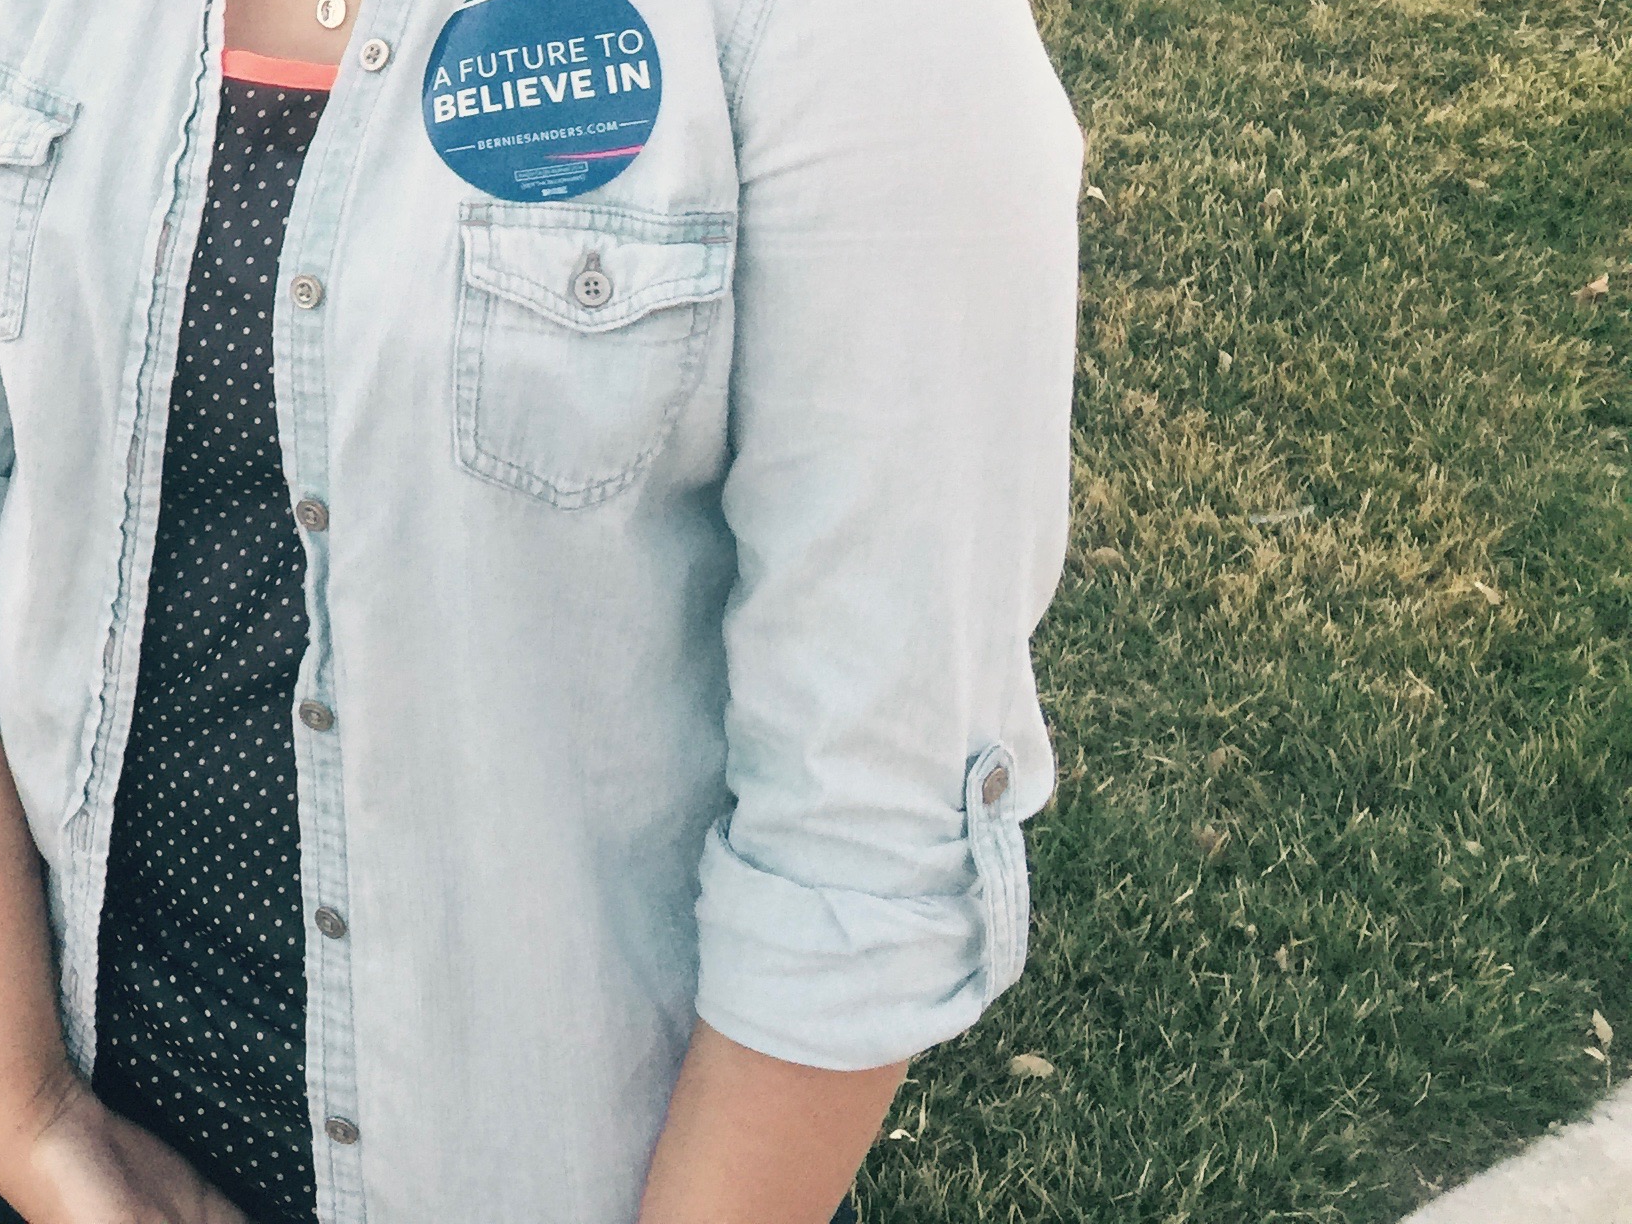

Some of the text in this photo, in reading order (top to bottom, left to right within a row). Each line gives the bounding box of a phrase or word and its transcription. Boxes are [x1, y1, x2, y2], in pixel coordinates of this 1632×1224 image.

[433, 28, 644, 91] A FUTURE TO
[433, 60, 651, 123] BELIEVE IN
[477, 121, 619, 150] BERNIESANDERS.COM
